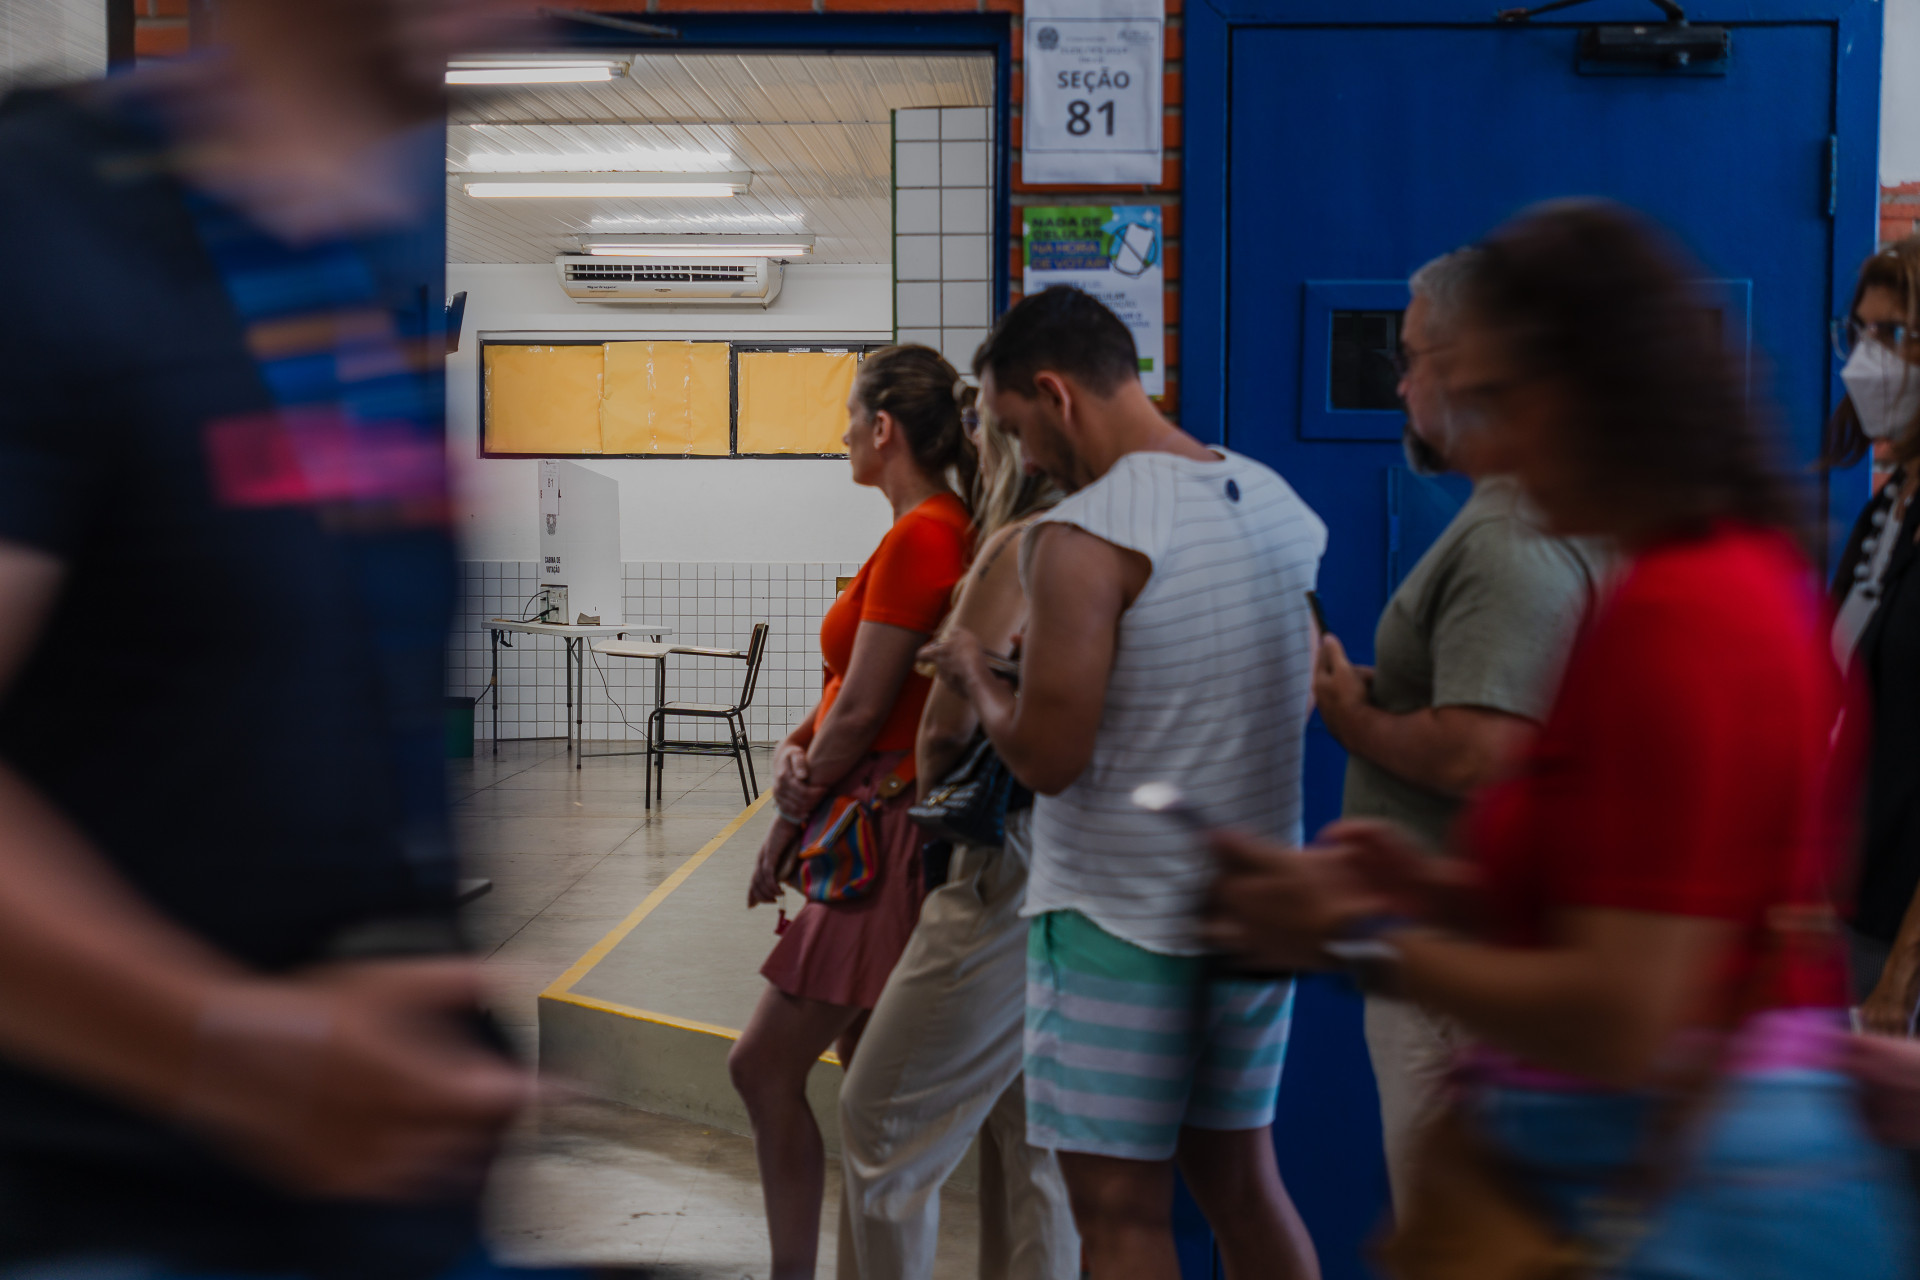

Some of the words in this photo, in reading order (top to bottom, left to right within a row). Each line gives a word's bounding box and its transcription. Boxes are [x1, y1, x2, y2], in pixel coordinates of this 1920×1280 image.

[1057, 66, 1131, 94] SEÇÃO
[1066, 99, 1115, 137] 81
[1033, 217, 1078, 227] NADA
[1081, 217, 1102, 227] DE
[1033, 228, 1104, 240] CELULAR
[1032, 243, 1053, 255] NA
[1056, 243, 1097, 254] HORA
